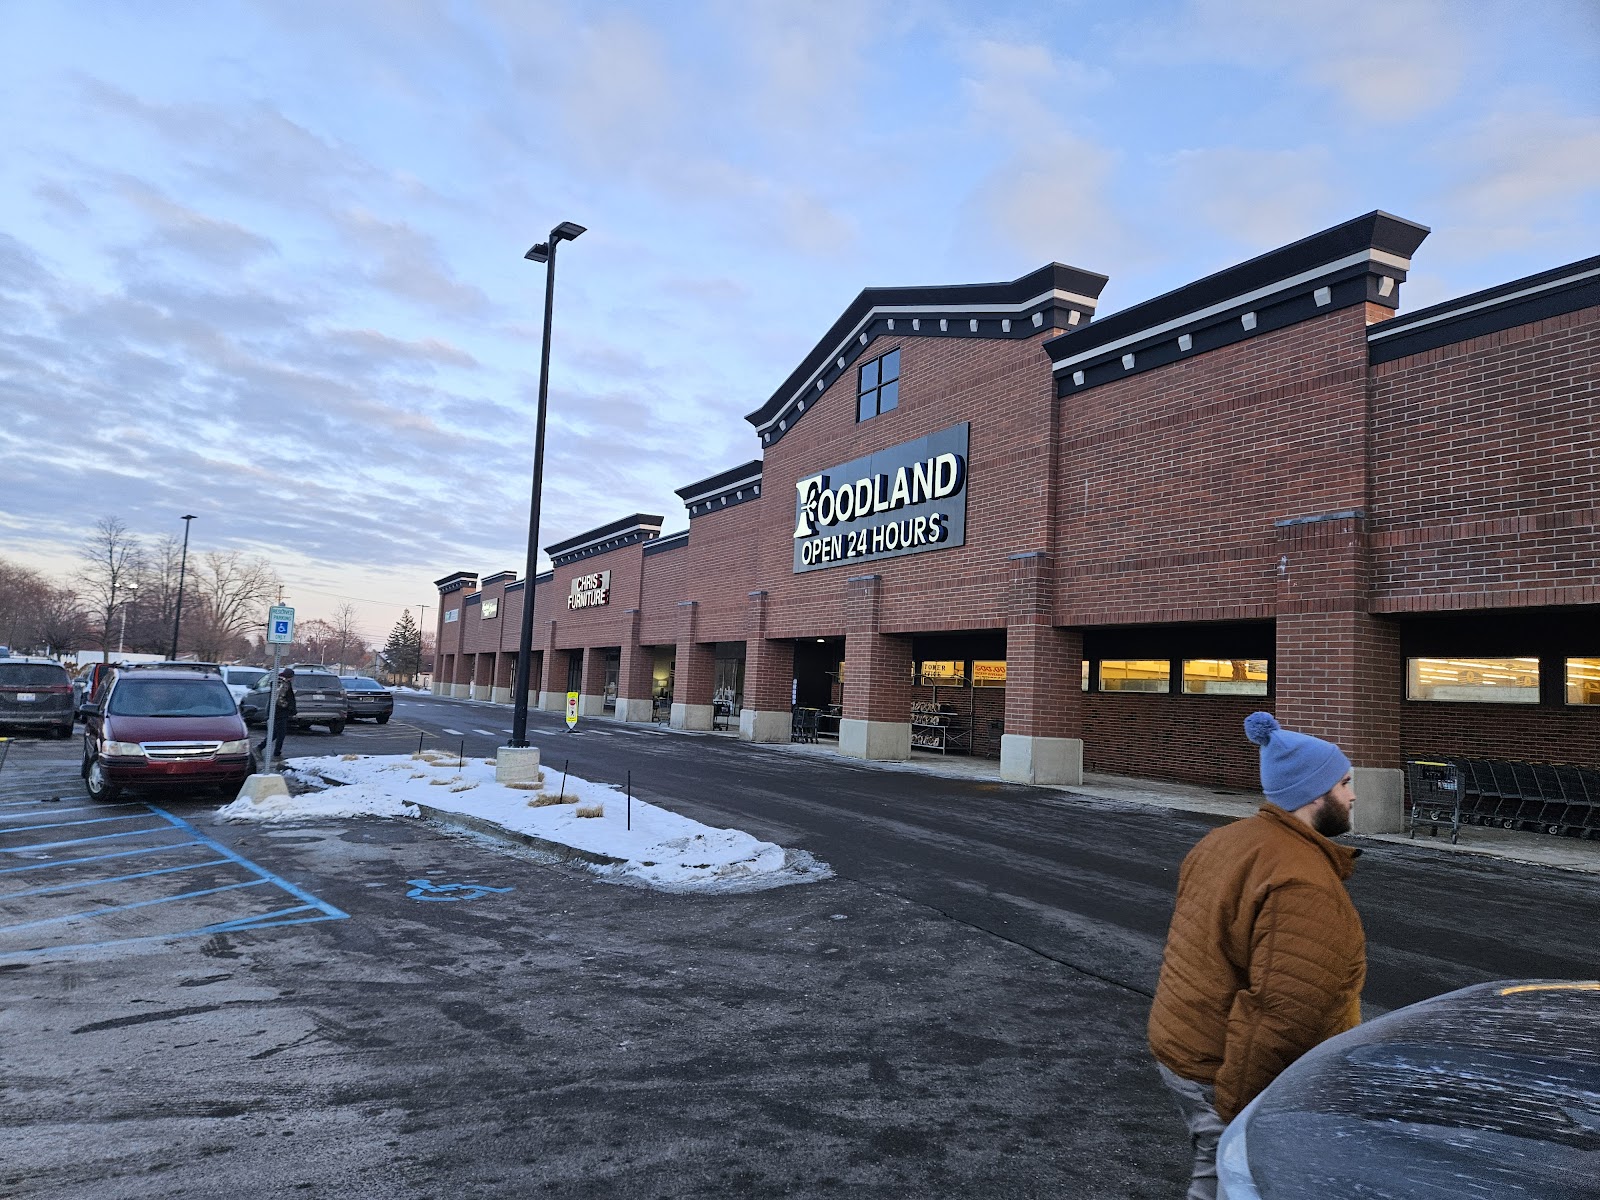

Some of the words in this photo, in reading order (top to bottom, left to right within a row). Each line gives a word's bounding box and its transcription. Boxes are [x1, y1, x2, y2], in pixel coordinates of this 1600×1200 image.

[793, 452, 959, 539] FOODLAND
[801, 533, 843, 566] OPEN
[846, 528, 869, 558] 24
[871, 512, 942, 552] HOURS
[567, 588, 607, 610] FURNITURE
[576, 572, 600, 592] CHRIS
